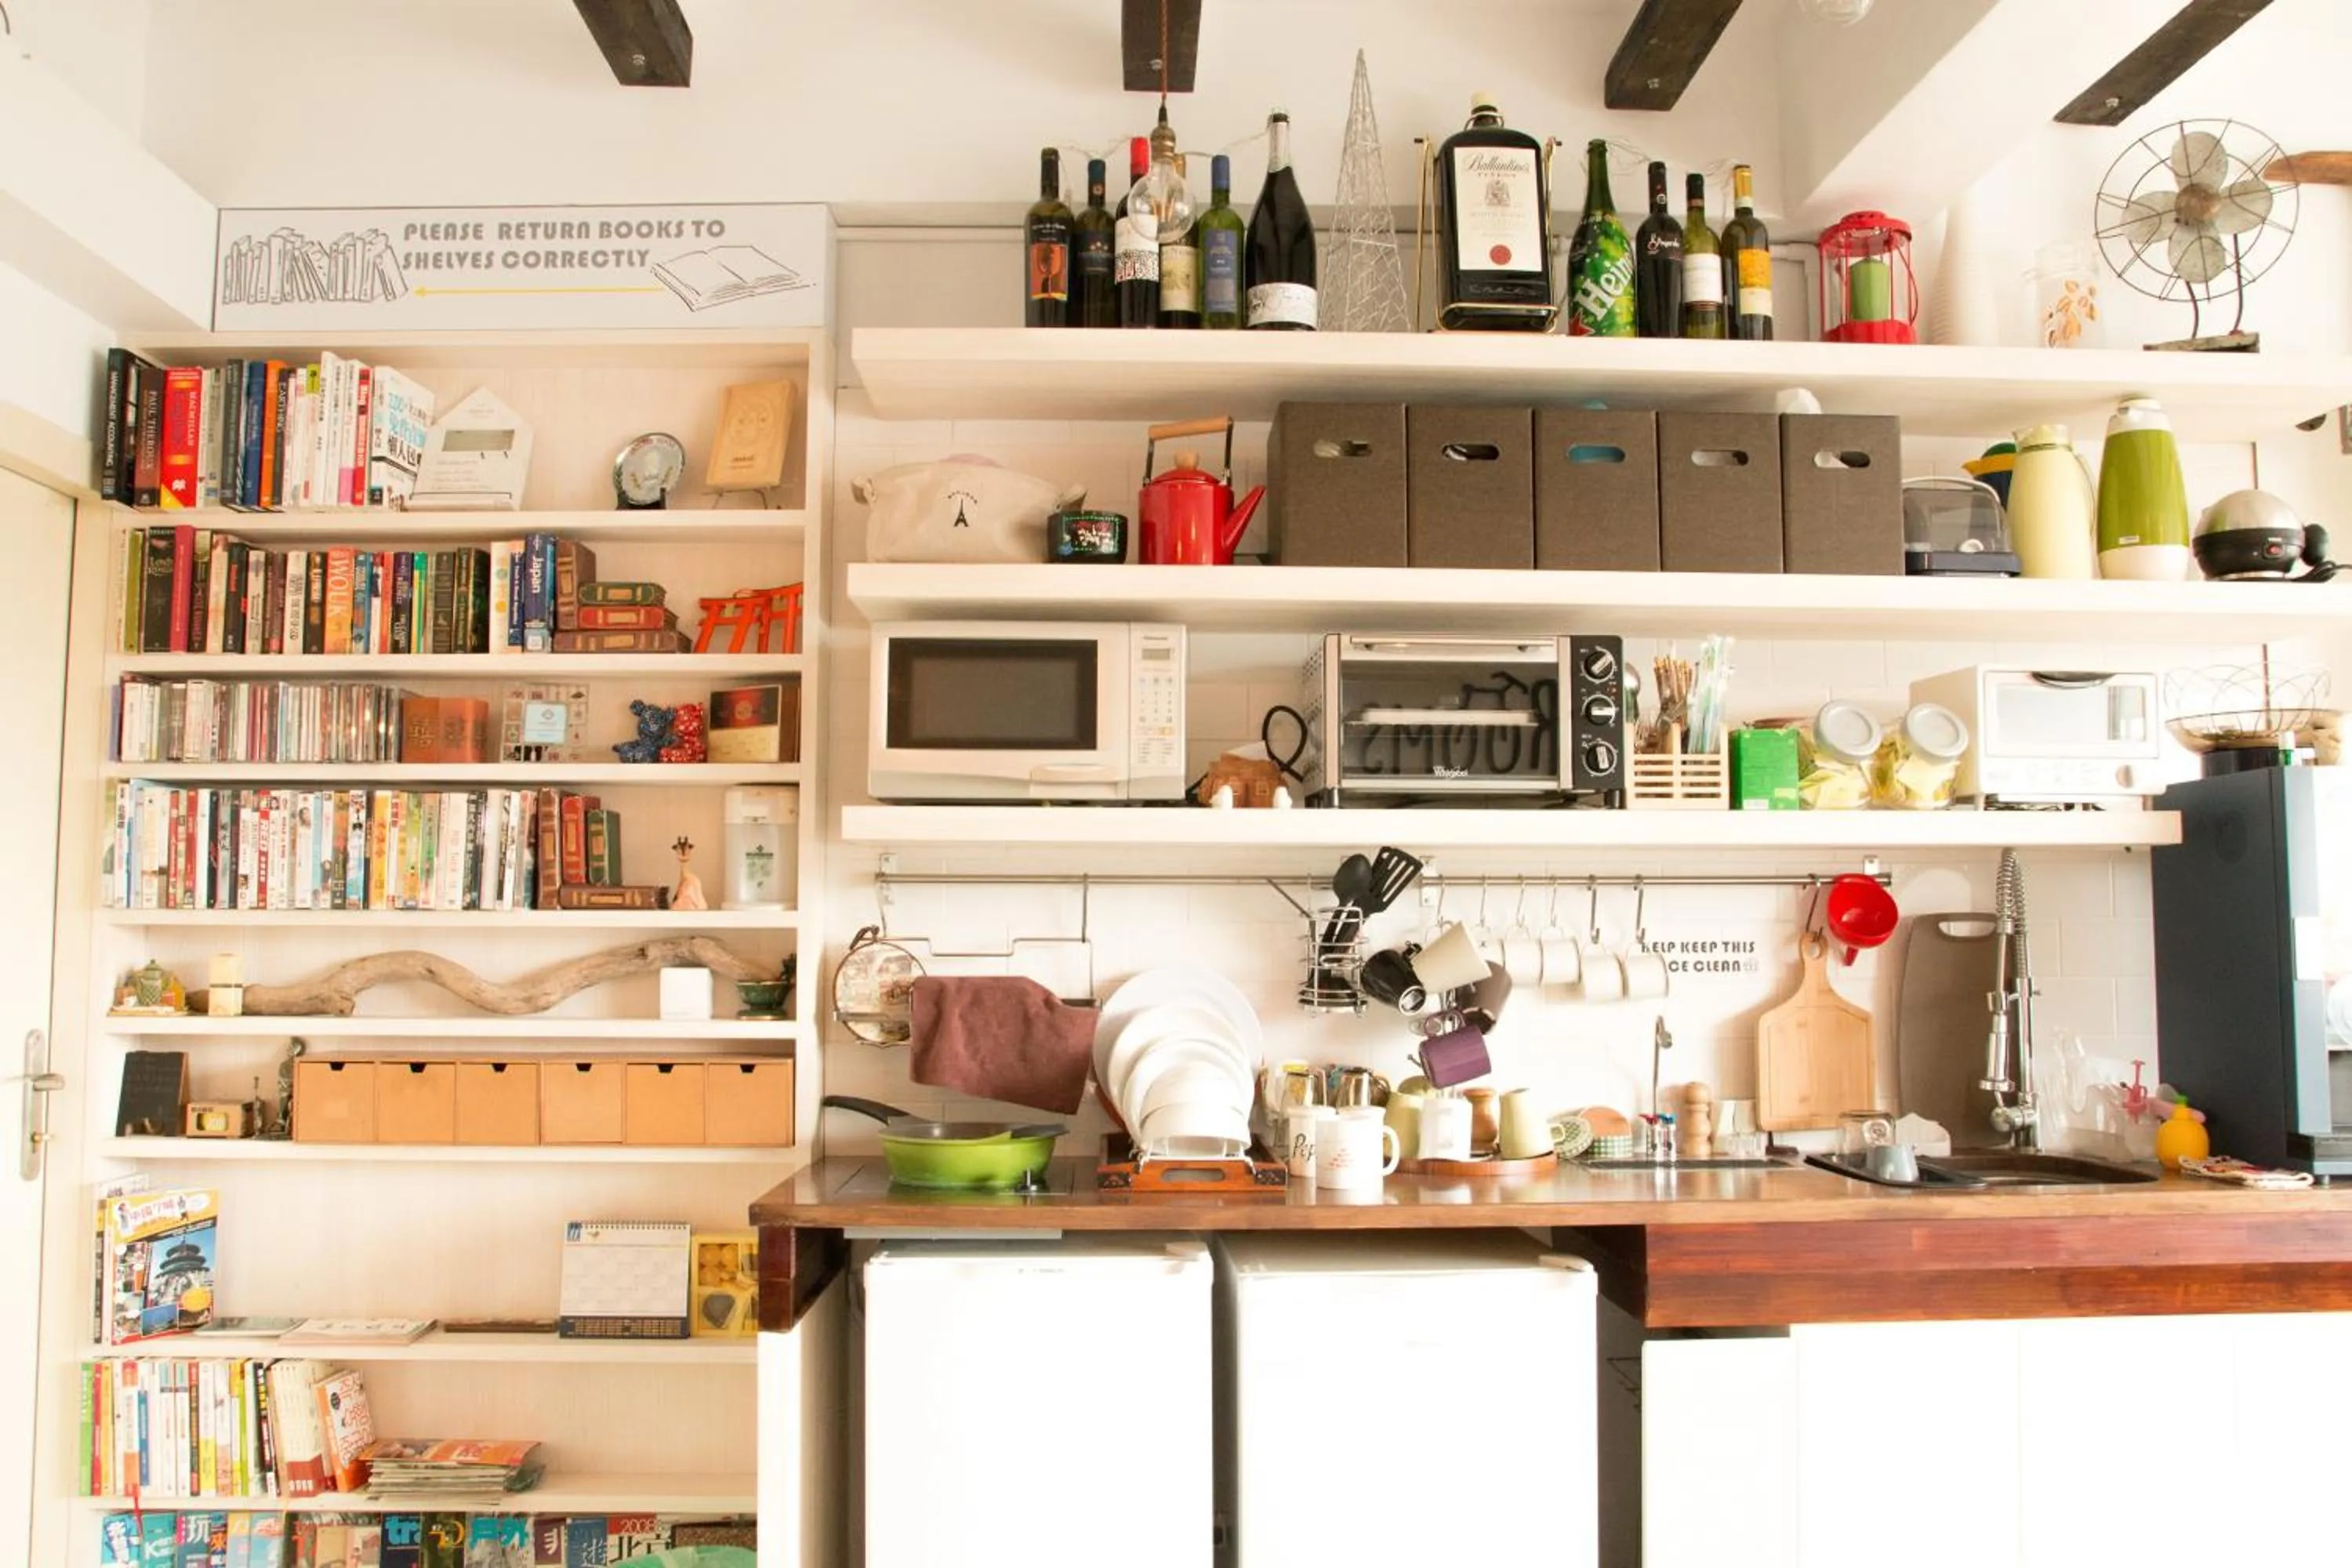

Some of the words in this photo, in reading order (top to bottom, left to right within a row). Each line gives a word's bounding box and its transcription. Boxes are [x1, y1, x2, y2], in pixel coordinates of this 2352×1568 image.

[1463, 152, 1531, 174] Ballantine's
[403, 220, 484, 242] PLEASE
[498, 220, 591, 241] RETURN
[598, 220, 684, 239] BOOKS
[691, 219, 727, 238] TO
[402, 249, 495, 270] SHELVES
[501, 248, 651, 270] CORRECTLY
[147, 390, 158, 416] PAUL
[105, 421, 116, 467] ACCOUNTING
[146, 417, 157, 470] THEROUX
[529, 555, 544, 594] Japan
[328, 559, 350, 618] WOUK
[1680, 941, 1718, 953] KEEP
[1721, 940, 1756, 954] THIS
[1693, 960, 1742, 973] CLEAN
